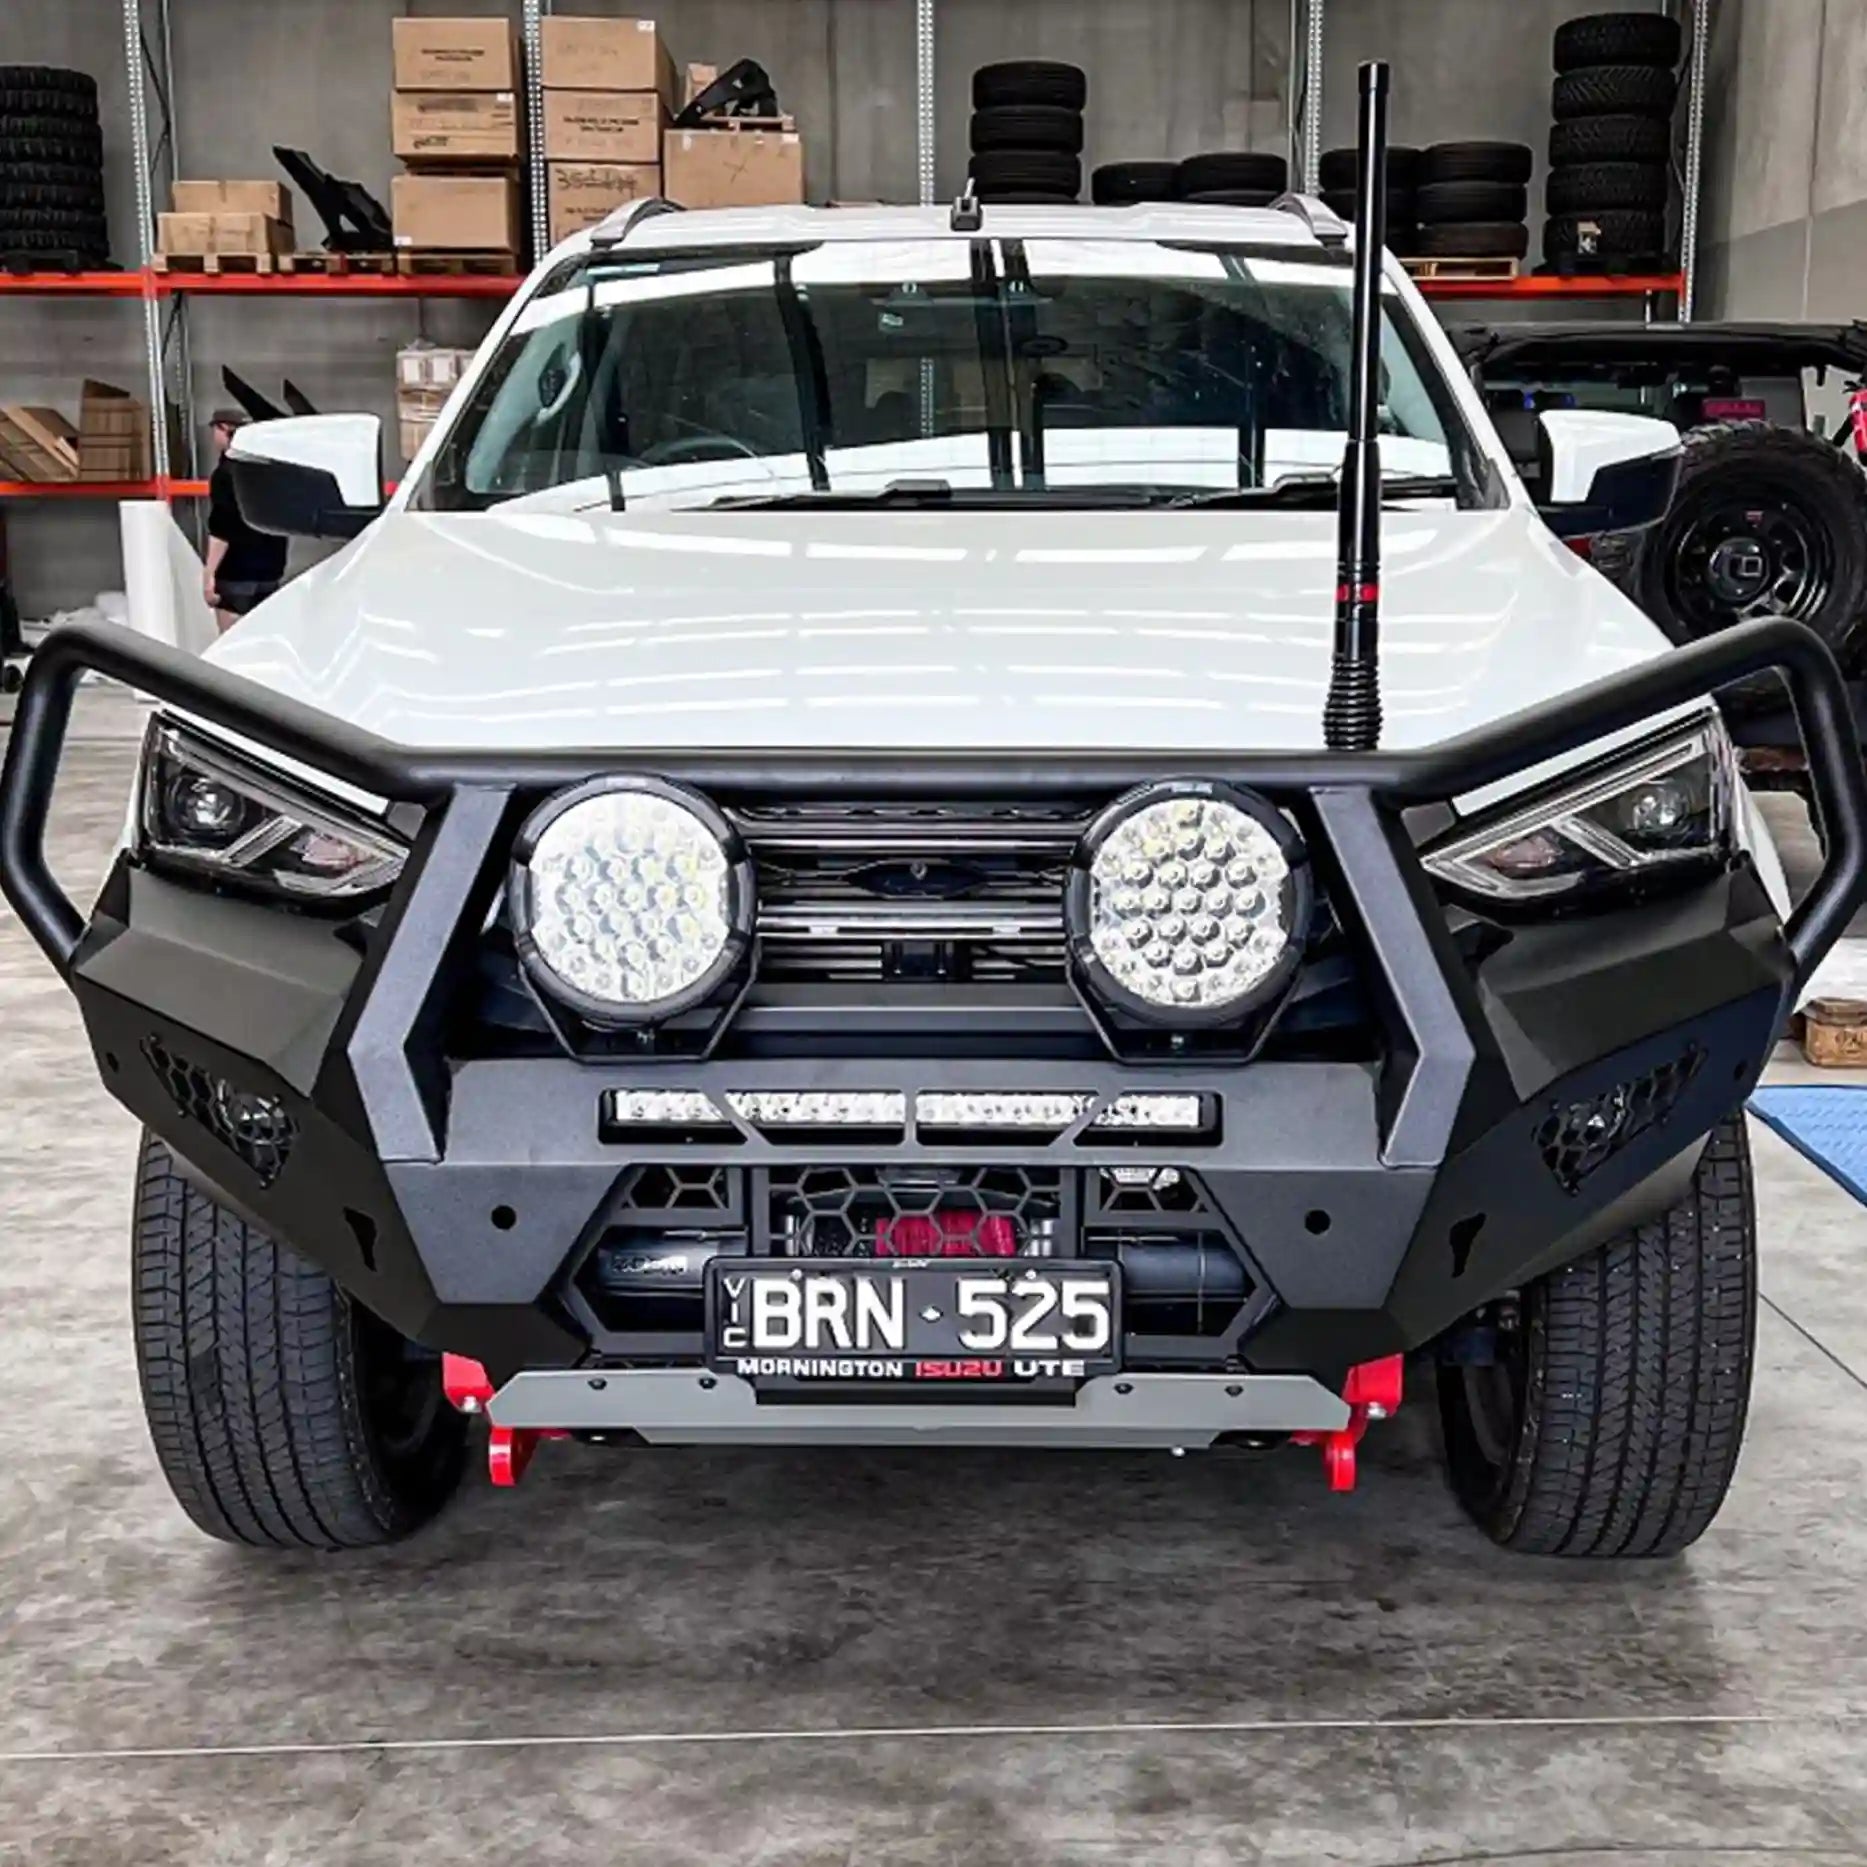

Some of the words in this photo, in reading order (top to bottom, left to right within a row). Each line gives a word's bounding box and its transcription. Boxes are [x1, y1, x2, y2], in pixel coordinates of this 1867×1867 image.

[723, 1277, 748, 1348] VIC
[752, 1276, 904, 1349] BRN
[957, 1278, 1111, 1351] 525
[736, 1358, 904, 1378] MORNINGTON
[914, 1360, 1004, 1378] ISUZU
[1013, 1359, 1086, 1378] UTE
